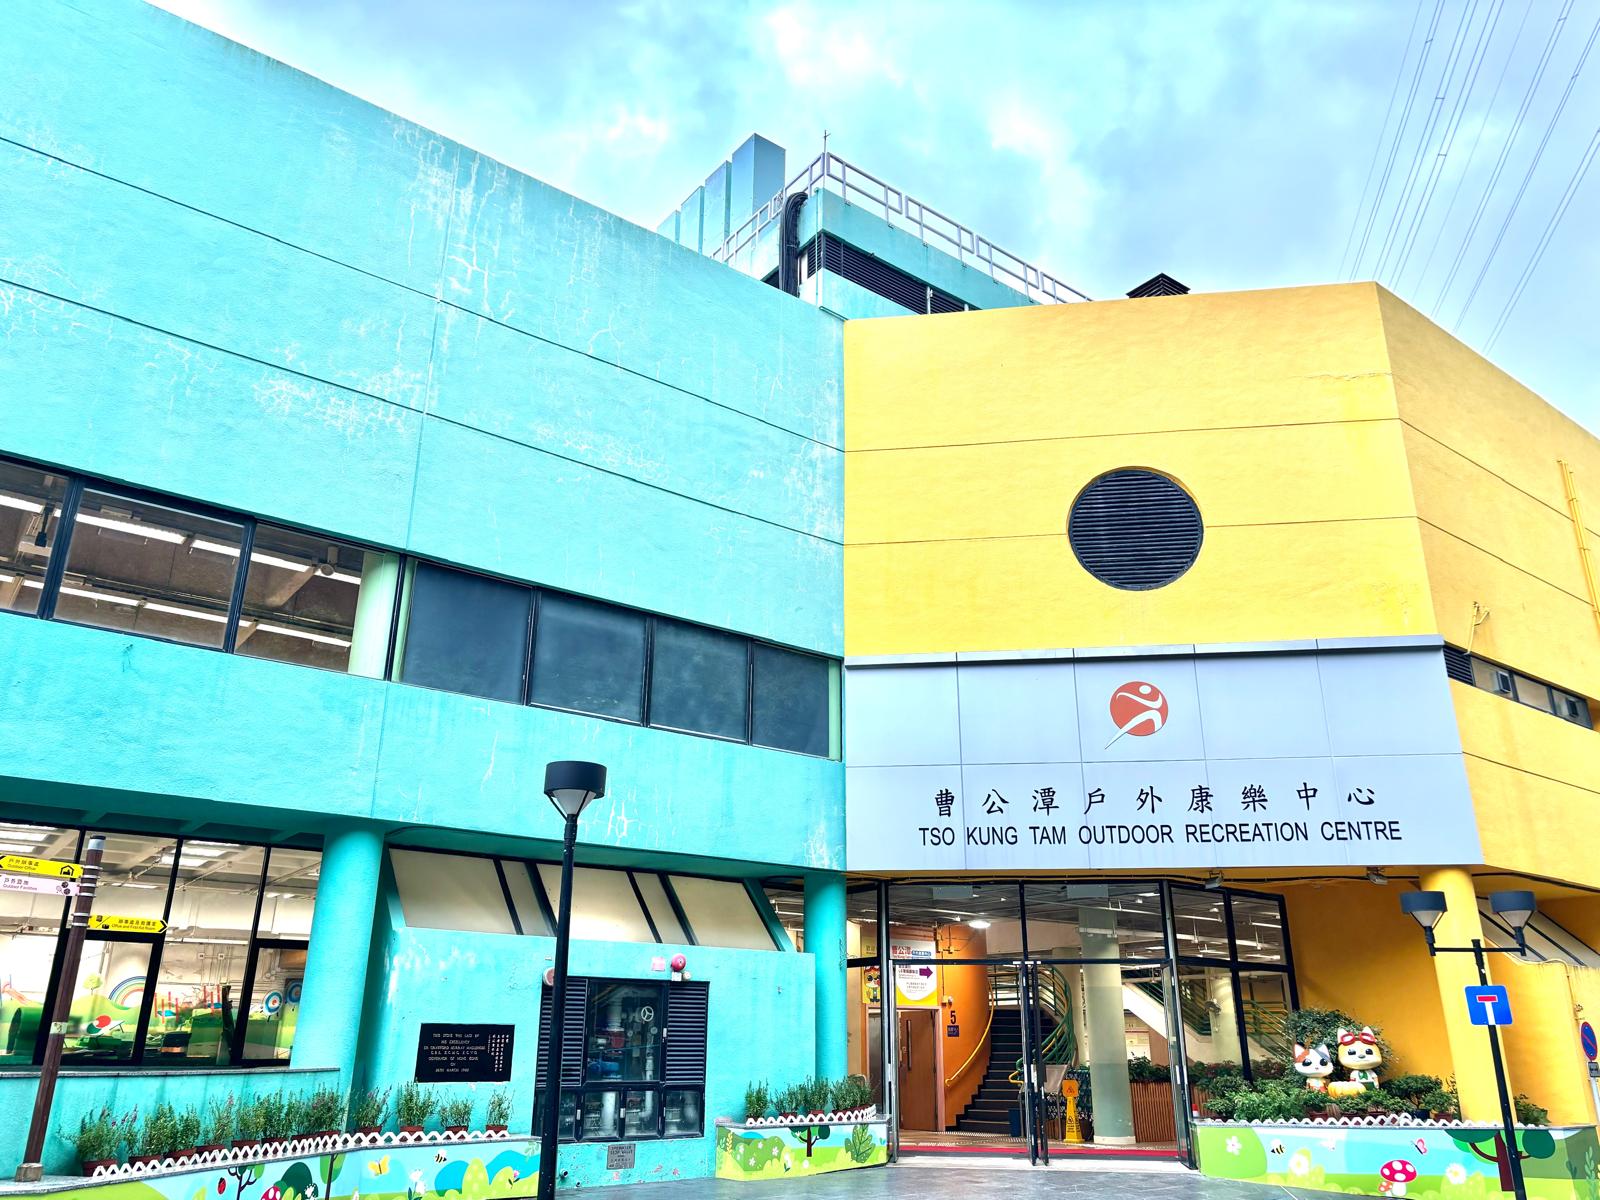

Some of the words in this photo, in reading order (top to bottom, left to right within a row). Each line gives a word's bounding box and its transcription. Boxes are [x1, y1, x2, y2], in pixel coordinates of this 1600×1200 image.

[934, 782, 1375, 818] 曹公潭戶外康樂中心
[919, 827, 955, 846] TSO
[966, 827, 1018, 846] KUNG
[1029, 826, 1067, 845] TAM
[1078, 825, 1174, 845] OUTDOOR
[1185, 822, 1309, 843] RECREATION
[1320, 820, 1402, 841] CENTRE
[950, 1010, 956, 1024] 5
